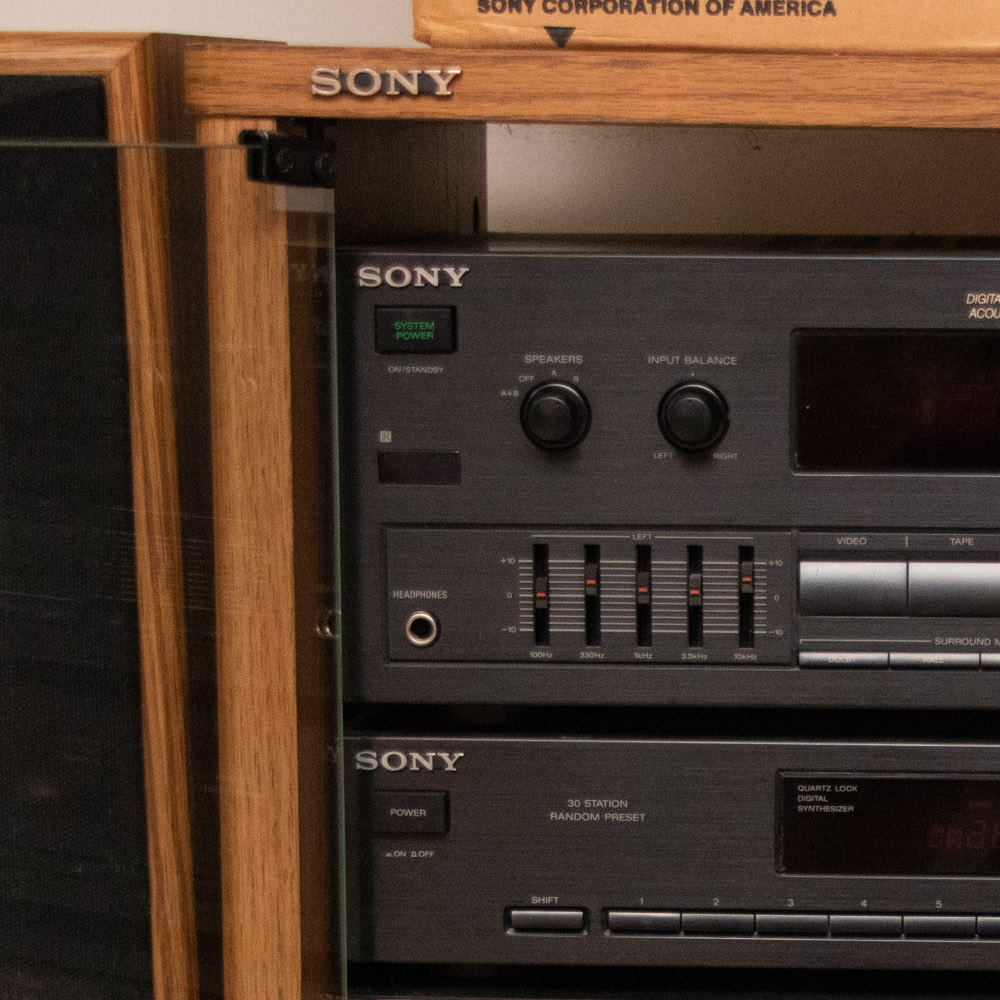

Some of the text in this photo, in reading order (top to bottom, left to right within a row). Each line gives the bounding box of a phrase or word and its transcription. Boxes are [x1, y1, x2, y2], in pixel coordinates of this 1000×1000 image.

[478, 0, 837, 17] SONY CORPORATION OF AMERICA
[311, 67, 461, 96] SONY
[358, 265, 470, 287] SONY
[394, 322, 435, 331] SYSTEM
[396, 332, 434, 340] POWER
[525, 355, 583, 364] SPEAKERS
[648, 356, 737, 365] INPUT BALANCE
[388, 366, 443, 374] ON/STANDBY
[836, 537, 867, 545] VIDEO
[950, 537, 974, 545] TAPE
[393, 590, 447, 599] HEADPHONES
[935, 637, 992, 645] SURROUND
[356, 751, 464, 771] SONY
[568, 800, 628, 808] 30 STATION
[390, 809, 427, 817] POWER
[550, 813, 646, 821] RANDOM PRESET
